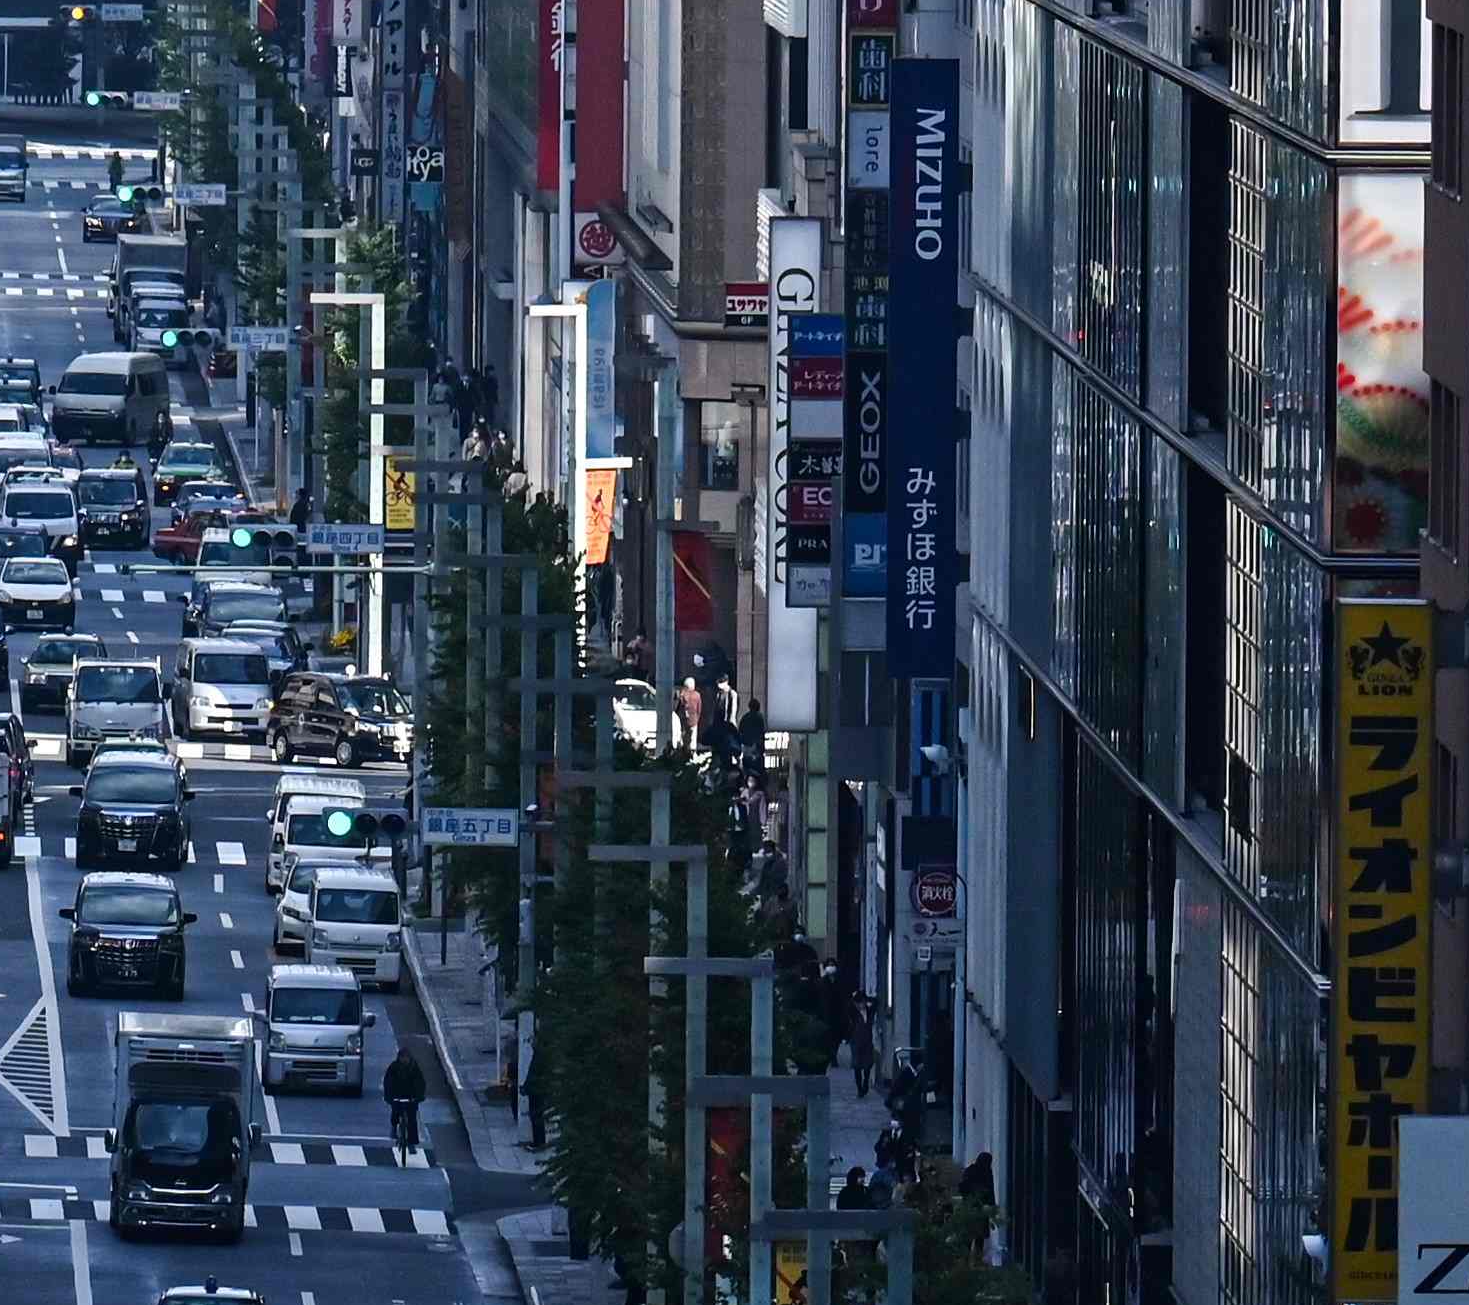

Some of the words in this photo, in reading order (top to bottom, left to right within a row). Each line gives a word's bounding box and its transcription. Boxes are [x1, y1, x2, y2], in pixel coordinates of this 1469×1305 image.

[859, 39, 887, 102] 歯科
[866, 126, 880, 173] lore
[914, 108, 947, 261] MIZUHO
[859, 371, 881, 494] GEOX
[905, 467, 938, 630] みずほ銀行
[1358, 684, 1414, 695] LION
[427, 816, 512, 833] 銀座五丁目
[1346, 715, 1419, 1253] ライオンビヤホール
